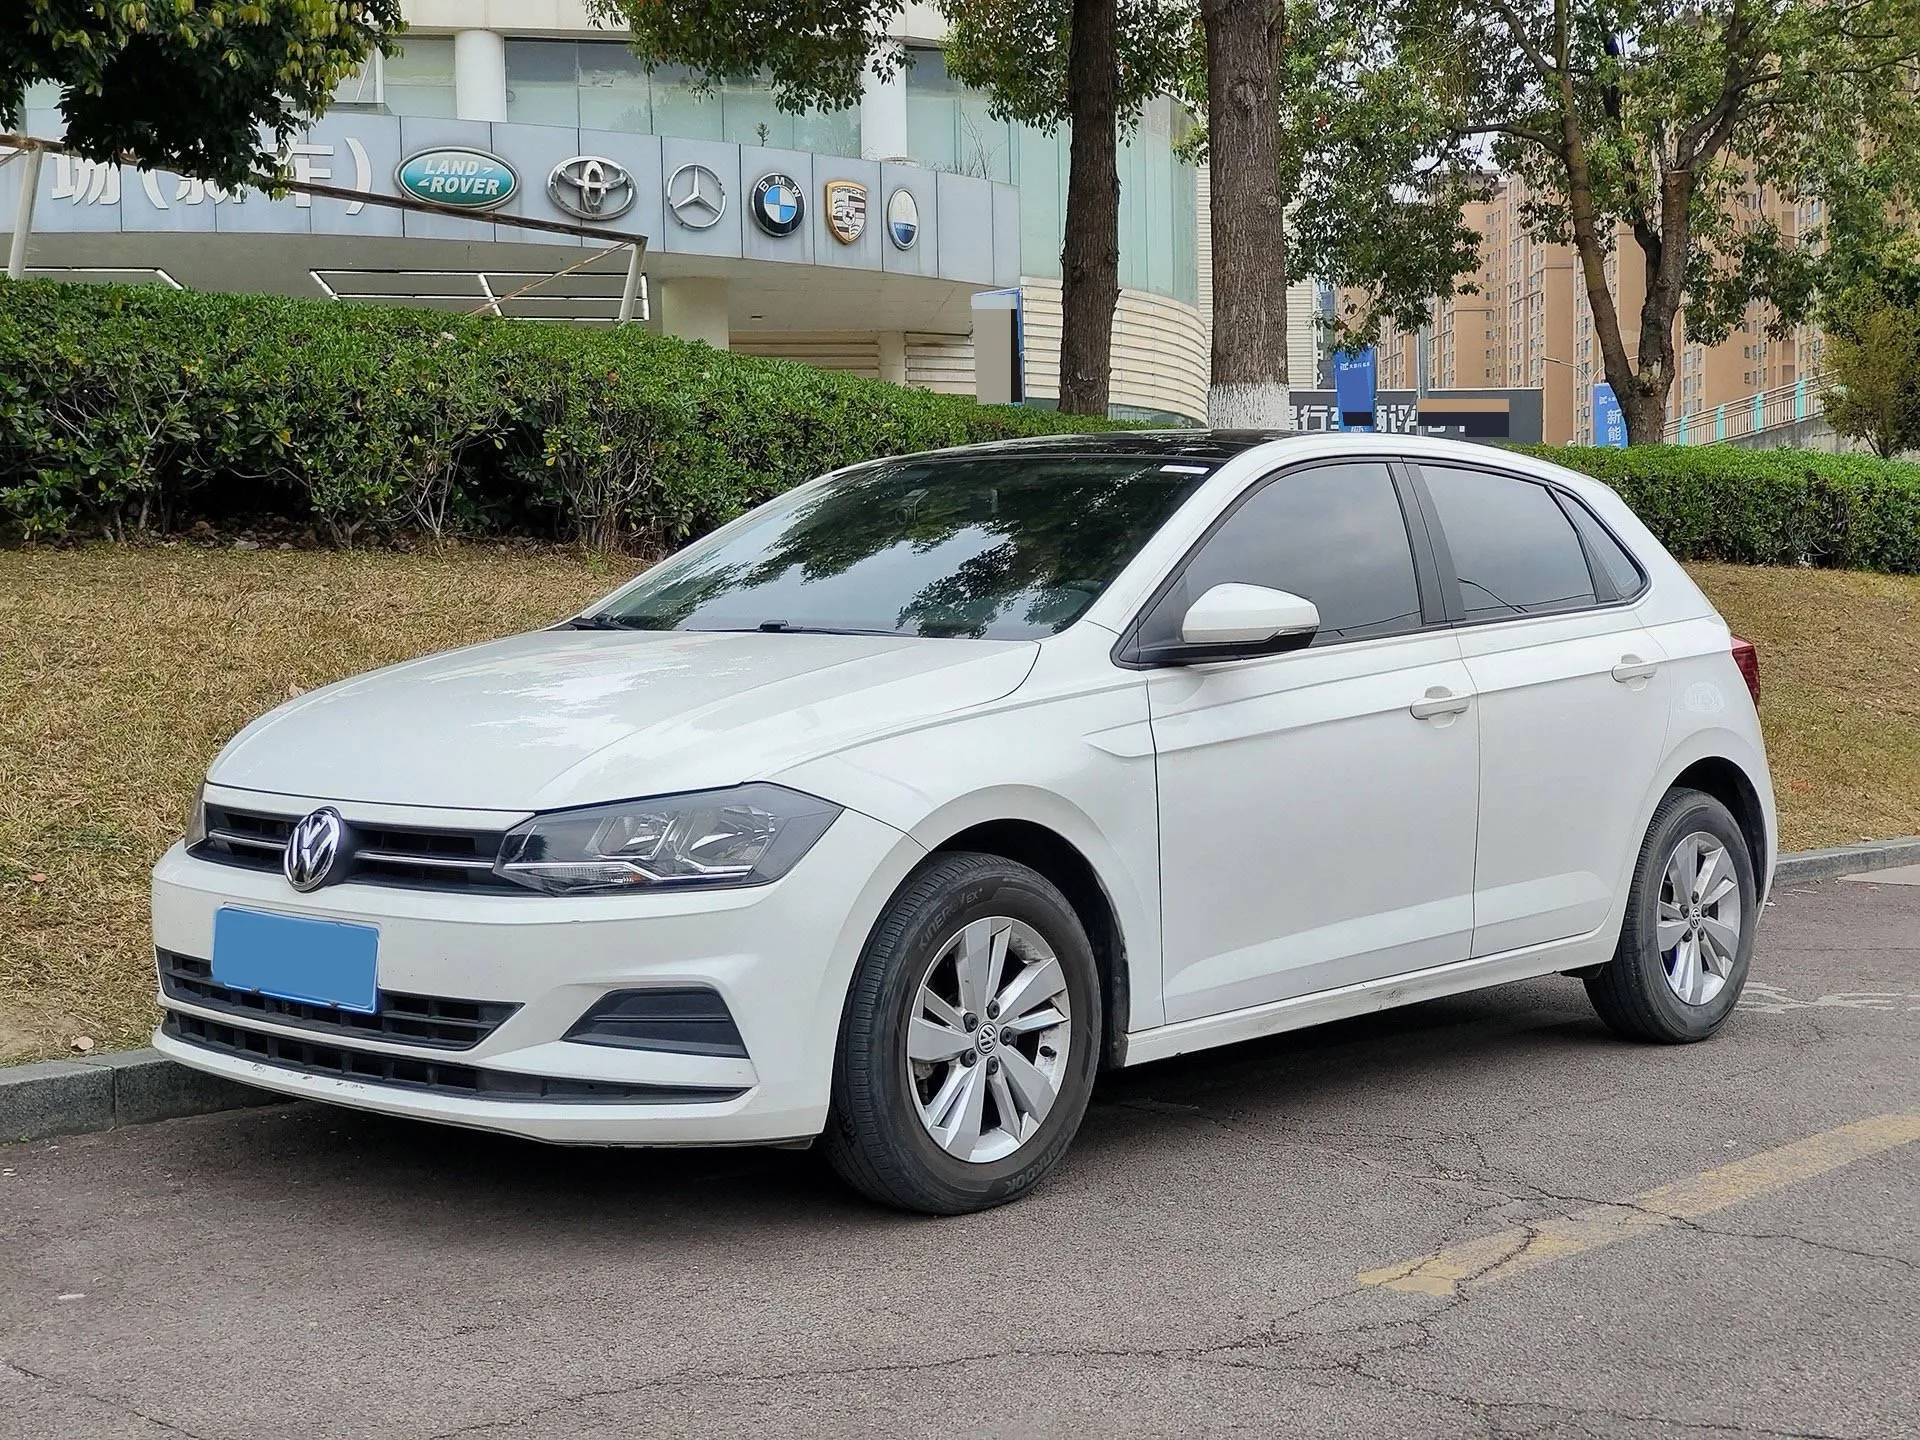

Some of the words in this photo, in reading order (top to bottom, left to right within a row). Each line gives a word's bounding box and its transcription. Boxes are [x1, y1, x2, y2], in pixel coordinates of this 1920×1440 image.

[424, 158, 478, 176] LAND
[429, 176, 500, 196] ROVER
[758, 175, 801, 198] BMW
[1606, 409, 1622, 447] 新能
